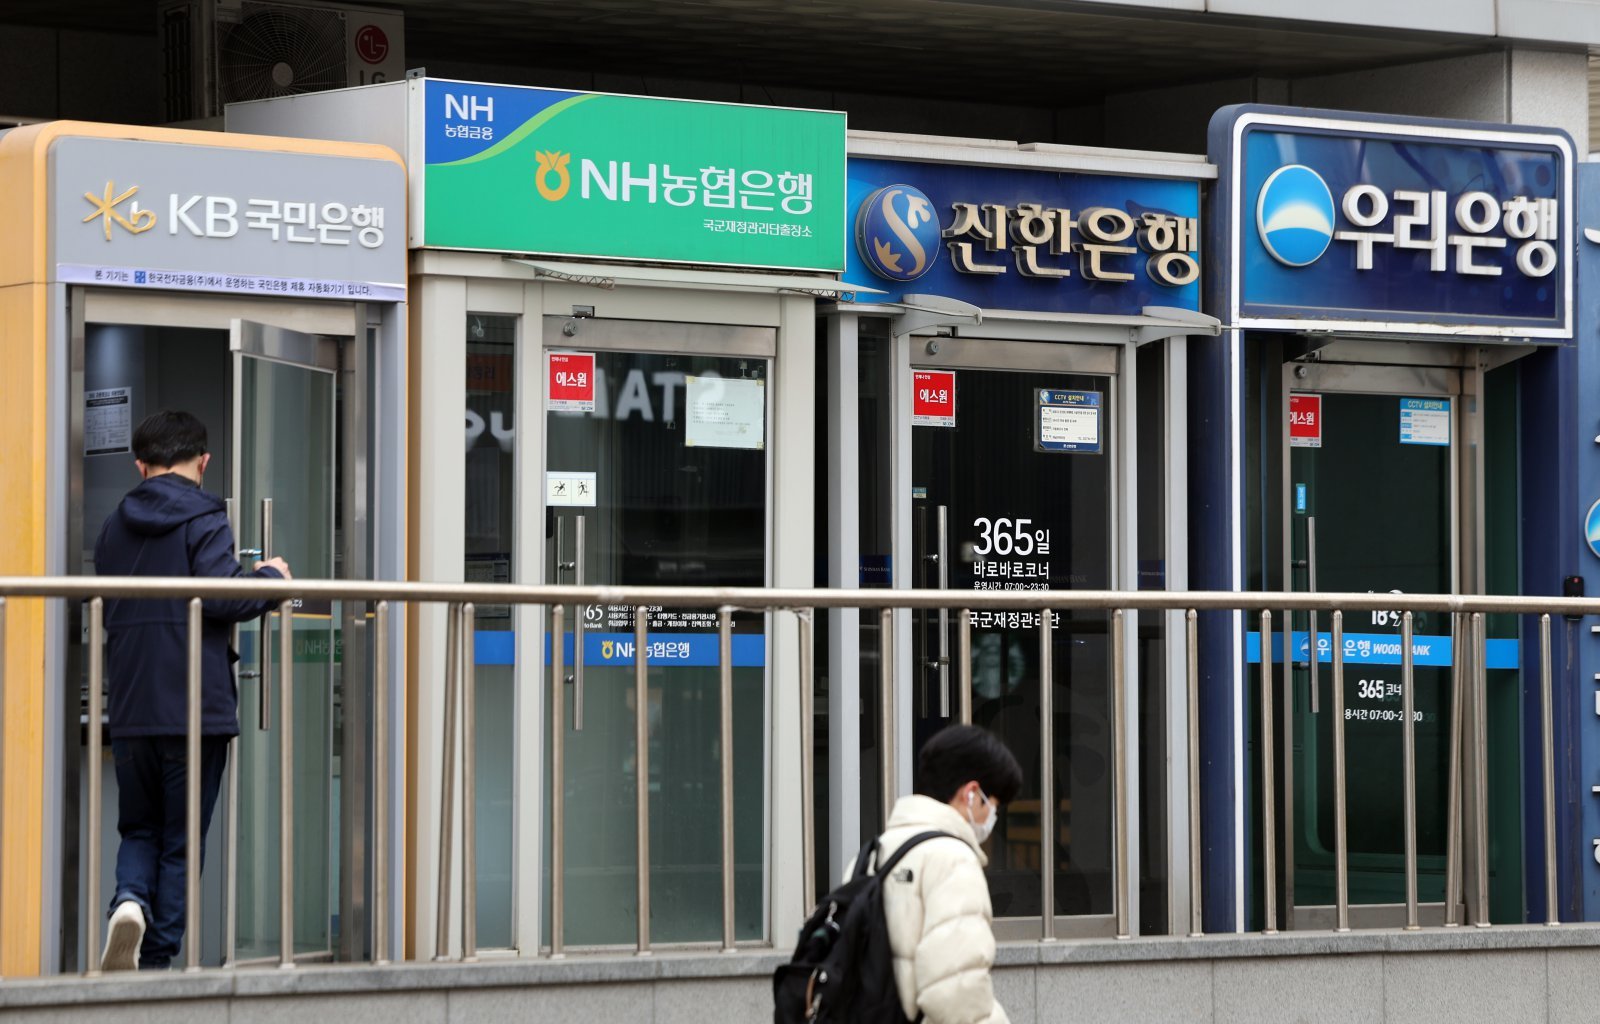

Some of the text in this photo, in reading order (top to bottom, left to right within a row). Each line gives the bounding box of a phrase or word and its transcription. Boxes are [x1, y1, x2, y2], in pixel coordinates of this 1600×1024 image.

[445, 93, 494, 122] NH
[444, 124, 494, 141] 농협금융
[581, 158, 814, 215] NH농협은행
[169, 193, 385, 248] KB 국민은행
[702, 218, 814, 239] 국군재정관리단출장소
[1335, 184, 1558, 277] 우리은행
[941, 202, 1200, 287] 신한은행
[95, 270, 103, 280] 본
[106, 271, 129, 282] 기기는
[225, 277, 255, 289] 운영하는
[258, 279, 287, 291] 국민은행
[290, 282, 305, 292] 제휴
[308, 283, 345, 295] 자동화기기
[348, 285, 373, 296] 입니다.
[555, 371, 588, 388] 에스원
[919, 388, 948, 404] 에스원
[1408, 400, 1423, 409] CCTV
[1289, 411, 1315, 426] 에스원
[973, 517, 1050, 556] 365일
[973, 561, 1049, 580] 바로바로코너
[583, 604, 603, 621] 65
[1317, 638, 1430, 657] 우은행 WOOR ANK
[1343, 709, 1423, 722] 용시간 07:00~230
